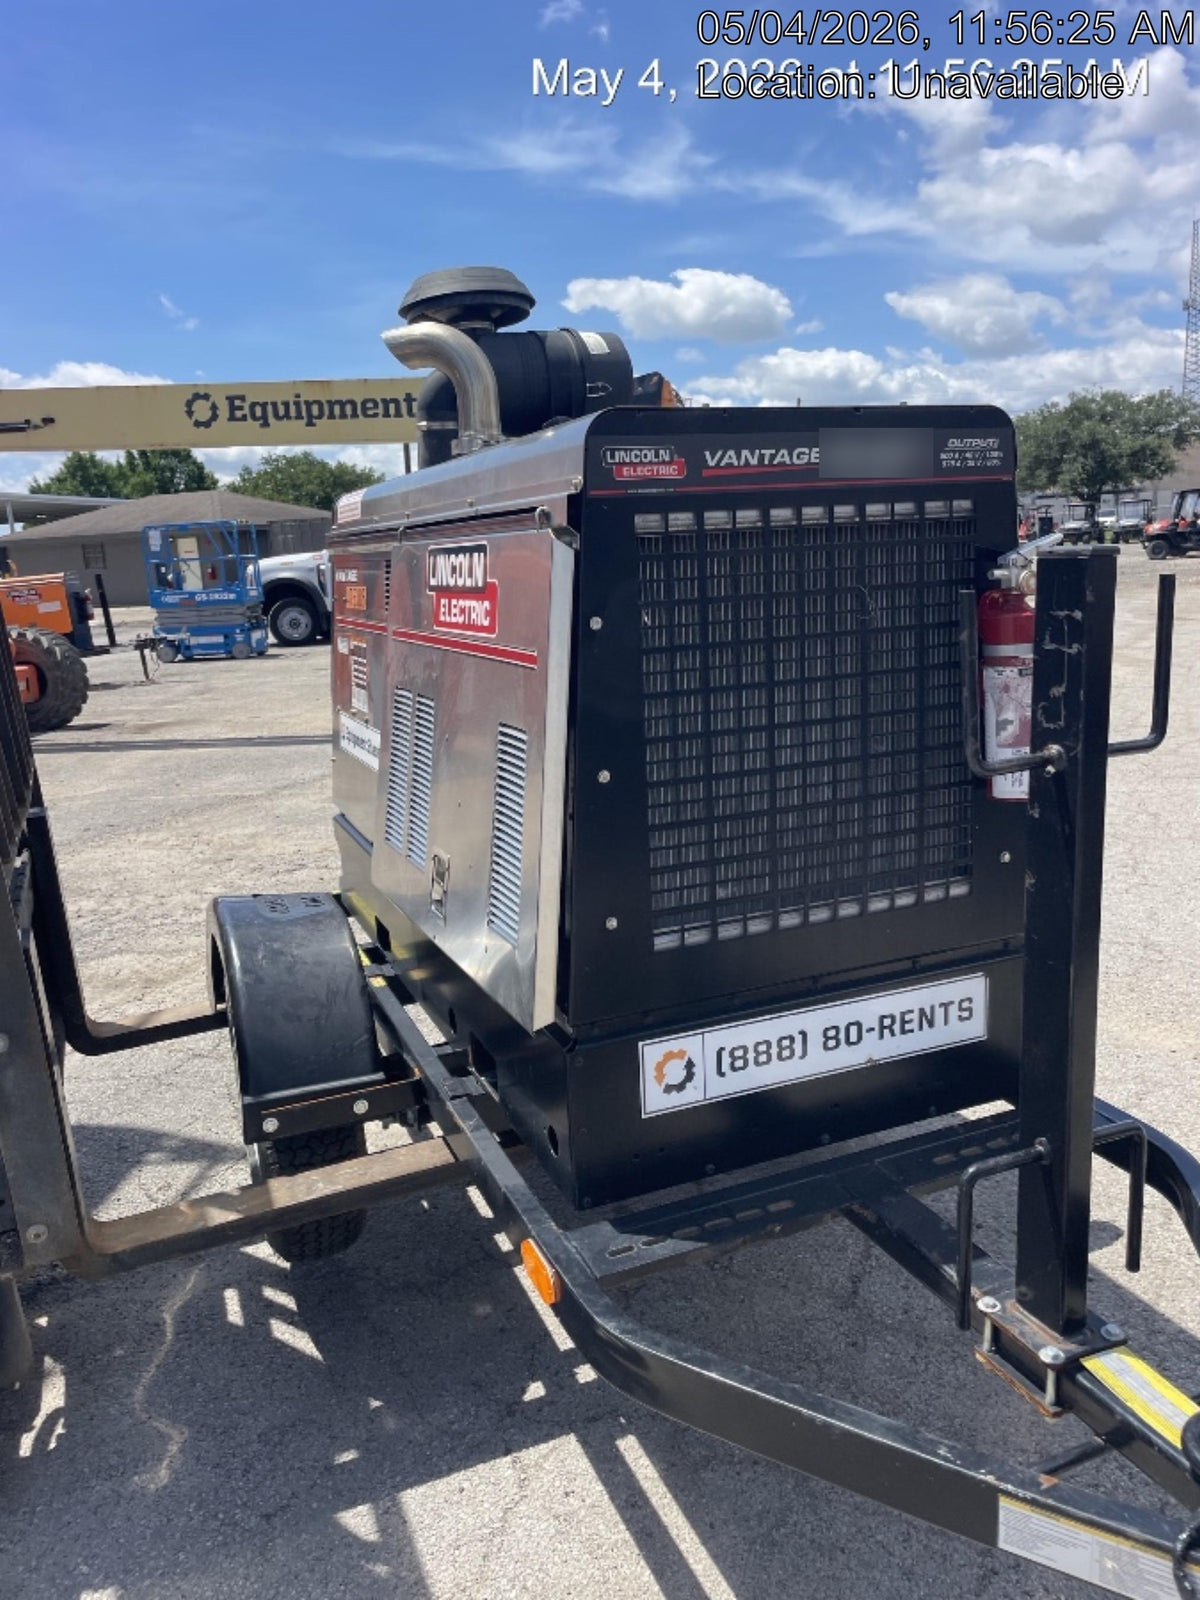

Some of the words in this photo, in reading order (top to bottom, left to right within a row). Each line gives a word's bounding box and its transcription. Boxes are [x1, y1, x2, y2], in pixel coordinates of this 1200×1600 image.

[226, 392, 418, 427] Equipment
[606, 449, 671, 464] LINCOLN
[703, 447, 821, 467] VANTAGE
[622, 465, 678, 478] ELECTRIC
[429, 552, 486, 587] LINCOLN
[439, 598, 491, 627] ELECTRIC
[715, 1030, 809, 1078] (888)
[822, 996, 975, 1053] 80-RENTS
